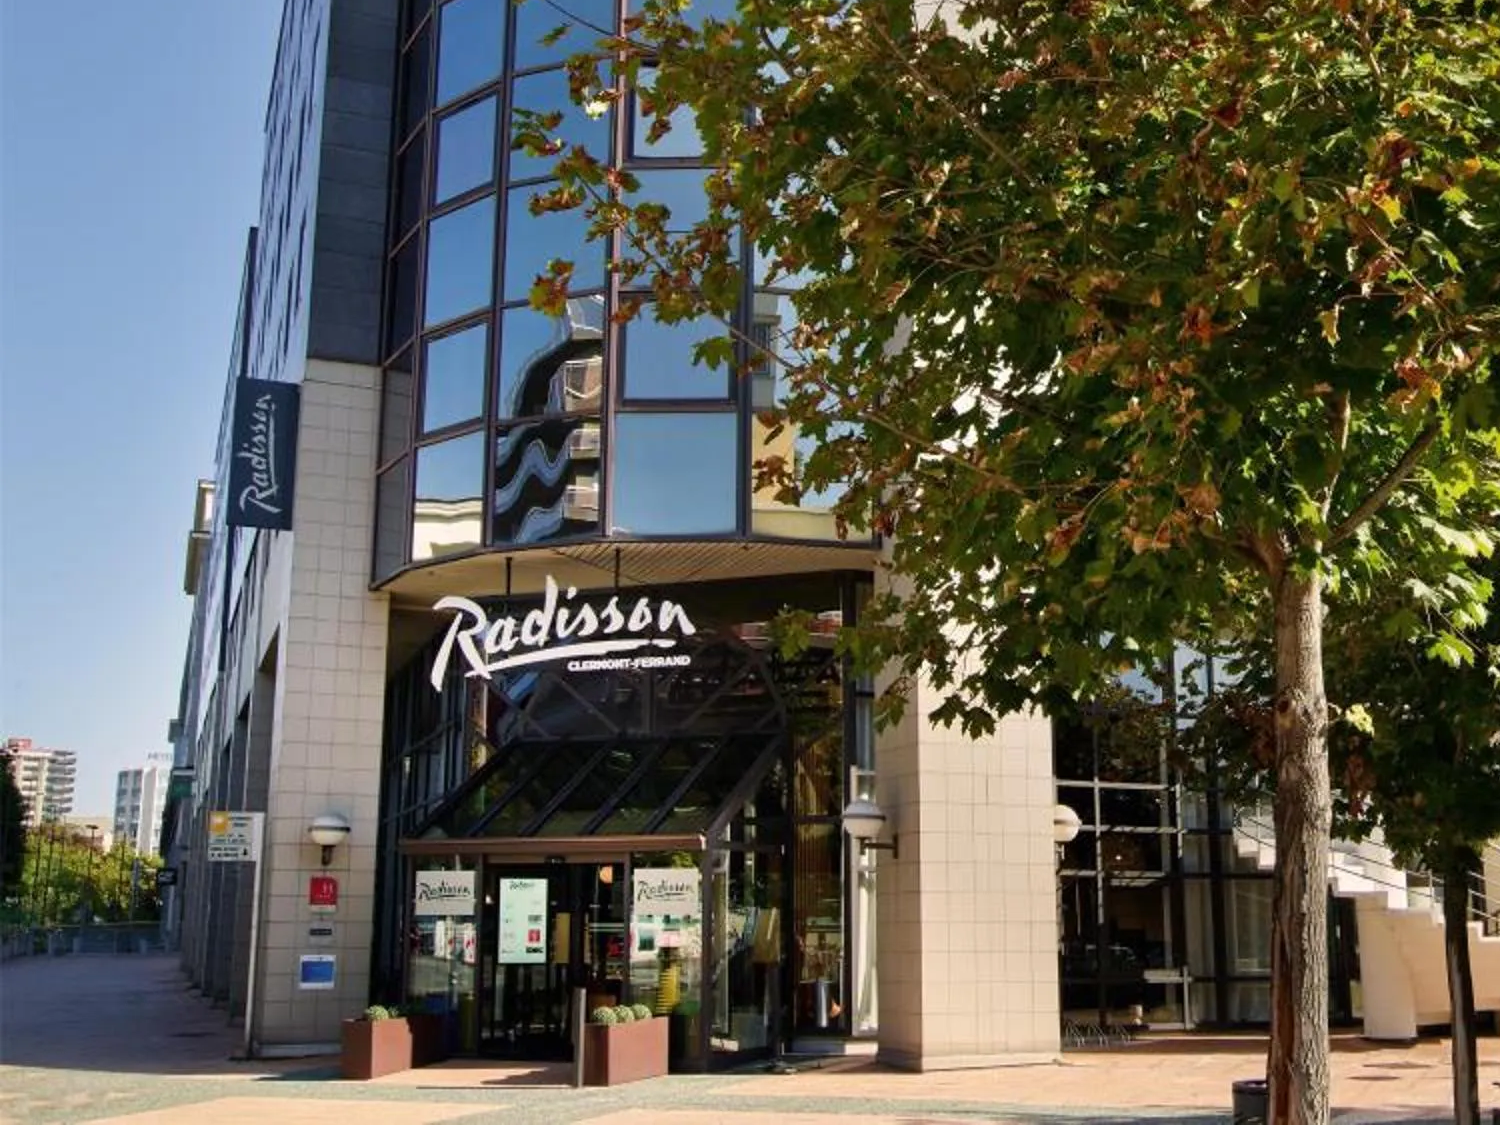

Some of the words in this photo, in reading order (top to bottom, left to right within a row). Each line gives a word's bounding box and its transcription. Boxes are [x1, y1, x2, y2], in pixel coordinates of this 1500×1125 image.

[237, 394, 283, 514] Radisson
[430, 575, 697, 693] Radisson
[567, 655, 692, 672] CLERMONT-FERRAND
